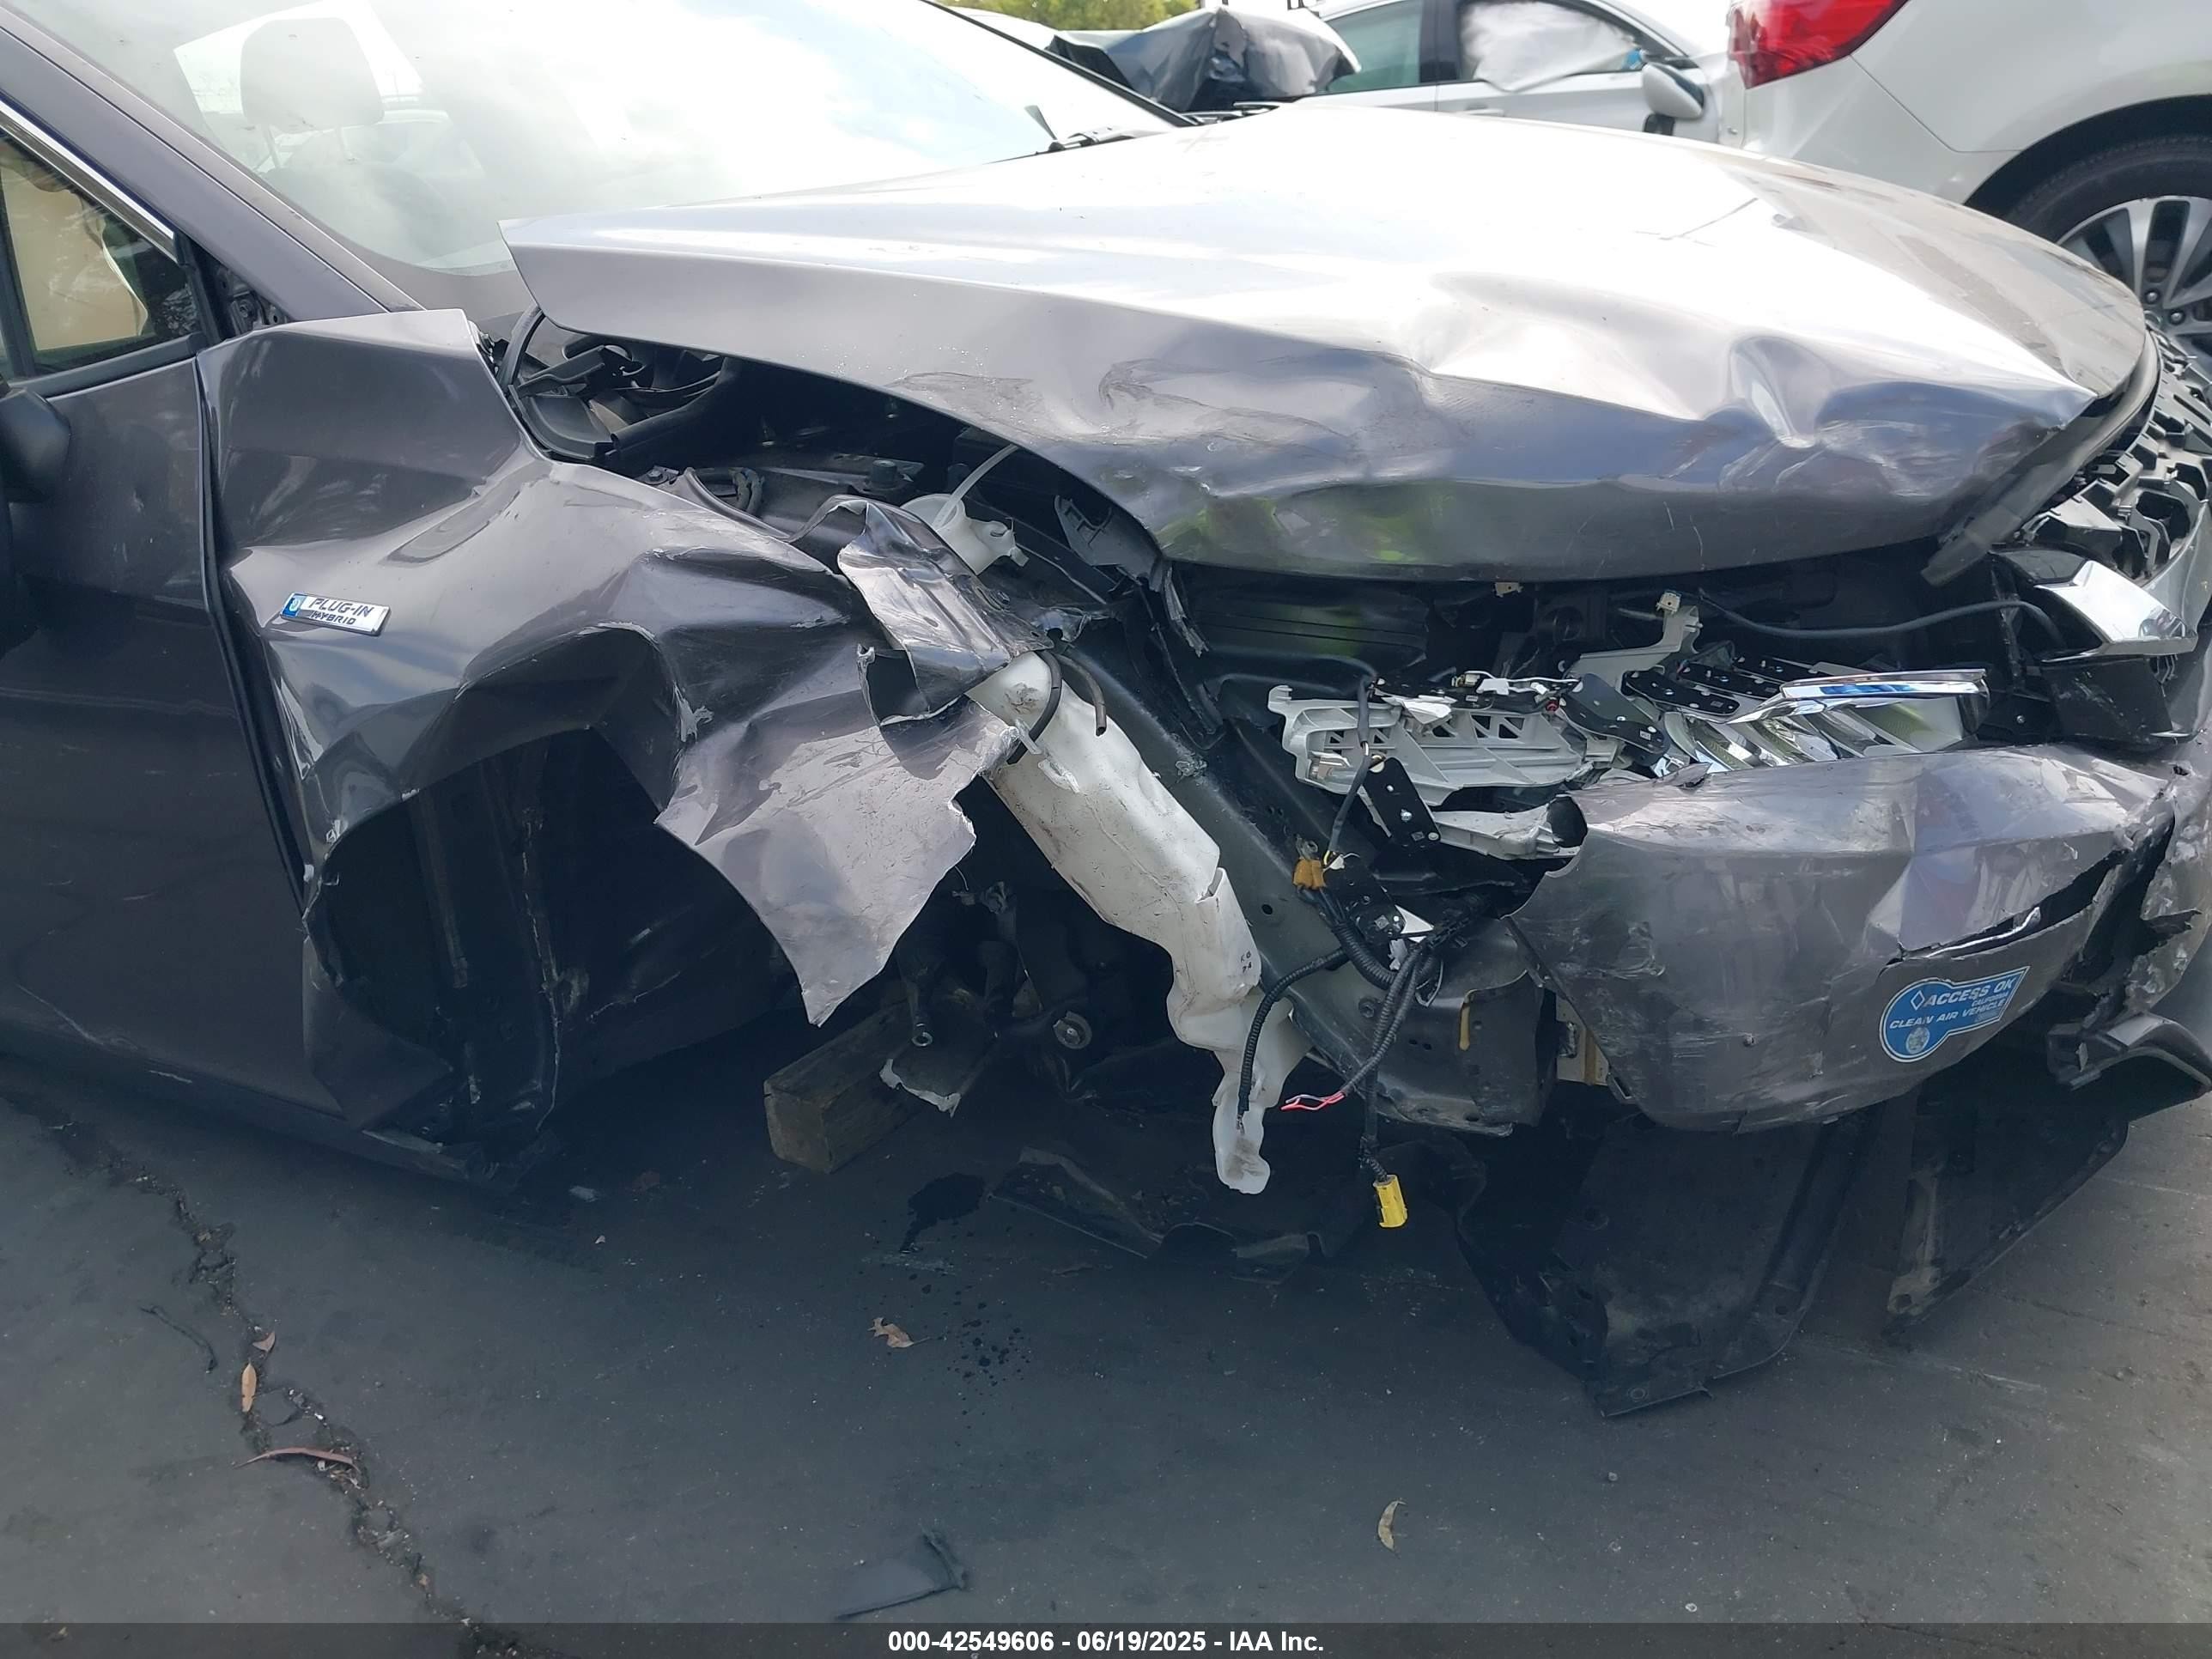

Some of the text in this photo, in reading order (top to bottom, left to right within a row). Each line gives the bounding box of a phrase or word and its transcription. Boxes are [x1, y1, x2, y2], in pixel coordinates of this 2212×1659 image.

[309, 598, 374, 617] PLUG-IN
[311, 611, 356, 625] HYBRID
[1923, 976, 2017, 1007] ACCESS OK
[1889, 1015, 1935, 1029] CLEAN
[1936, 1011, 1959, 1022] AIR
[1962, 998, 2006, 1017] VEHICLE
